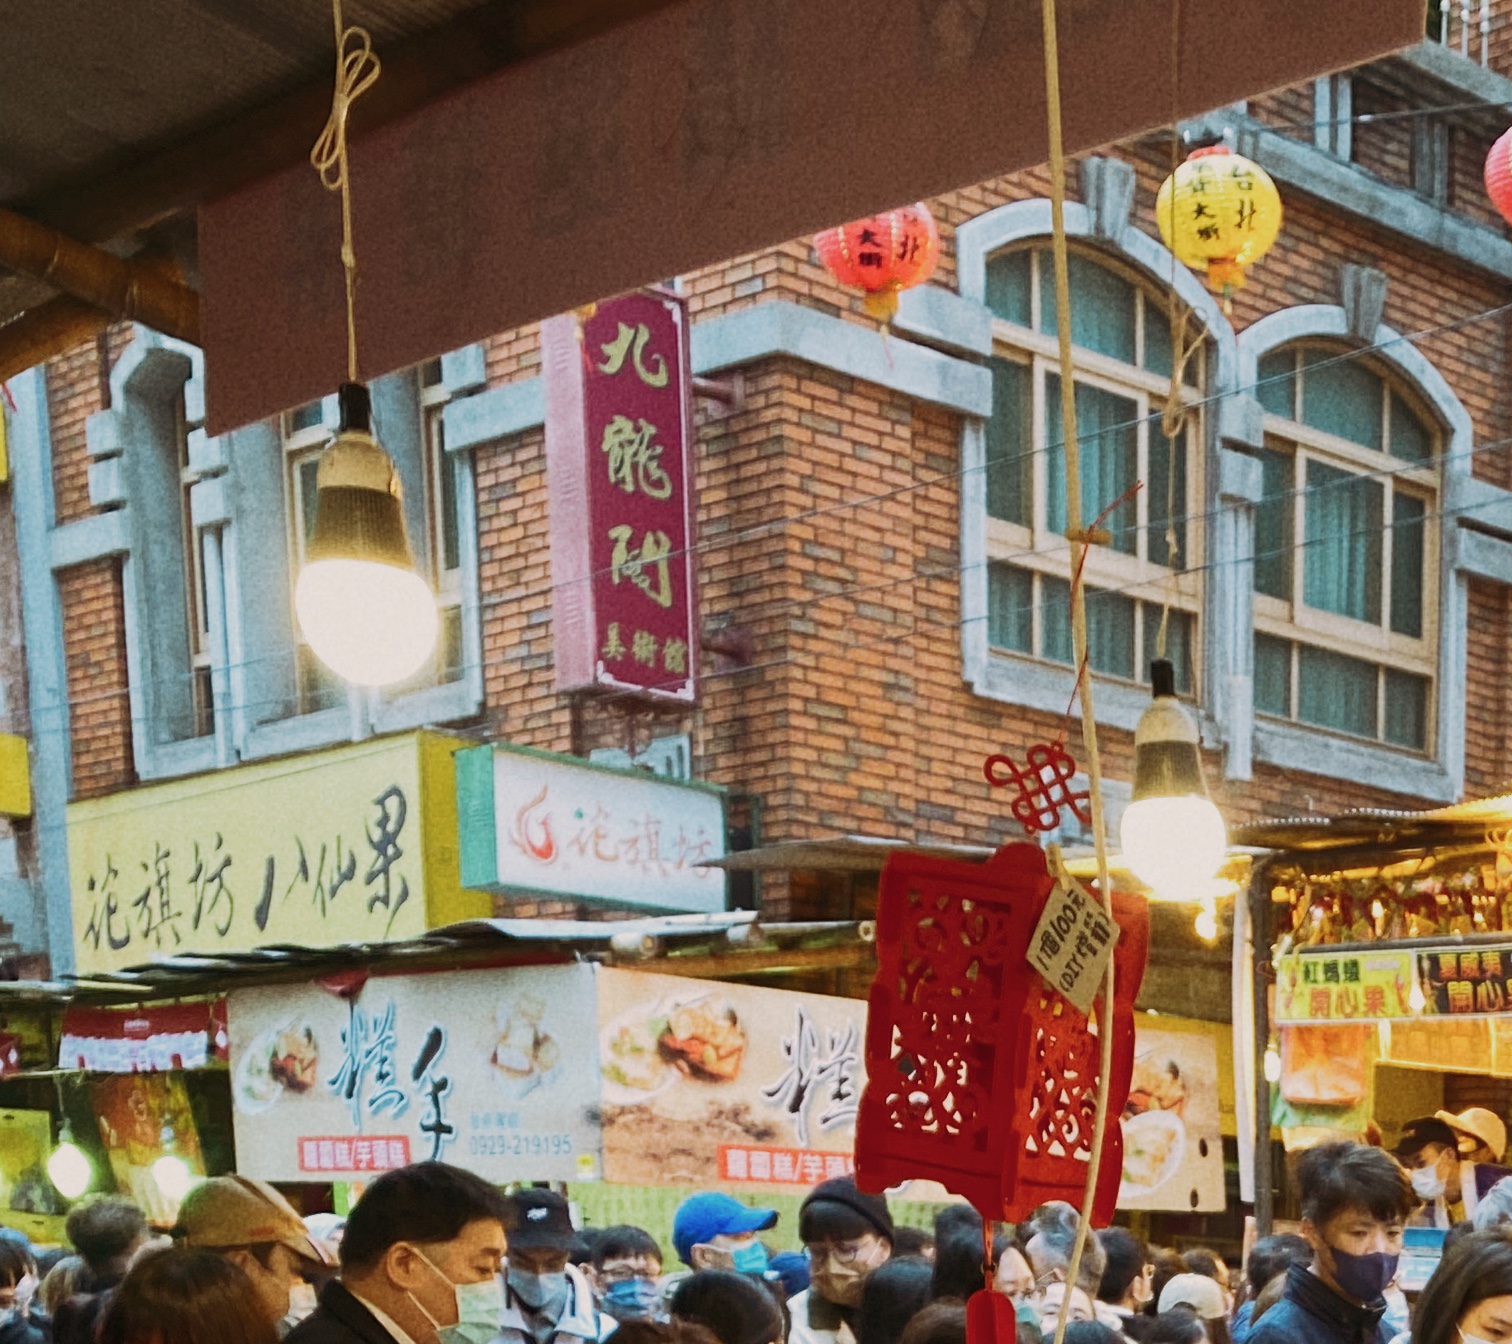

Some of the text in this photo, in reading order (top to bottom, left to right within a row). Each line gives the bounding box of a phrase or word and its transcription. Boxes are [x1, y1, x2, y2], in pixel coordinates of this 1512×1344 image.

[1232, 165, 1256, 232] 台北
[1309, 986, 1388, 1018] 開心果
